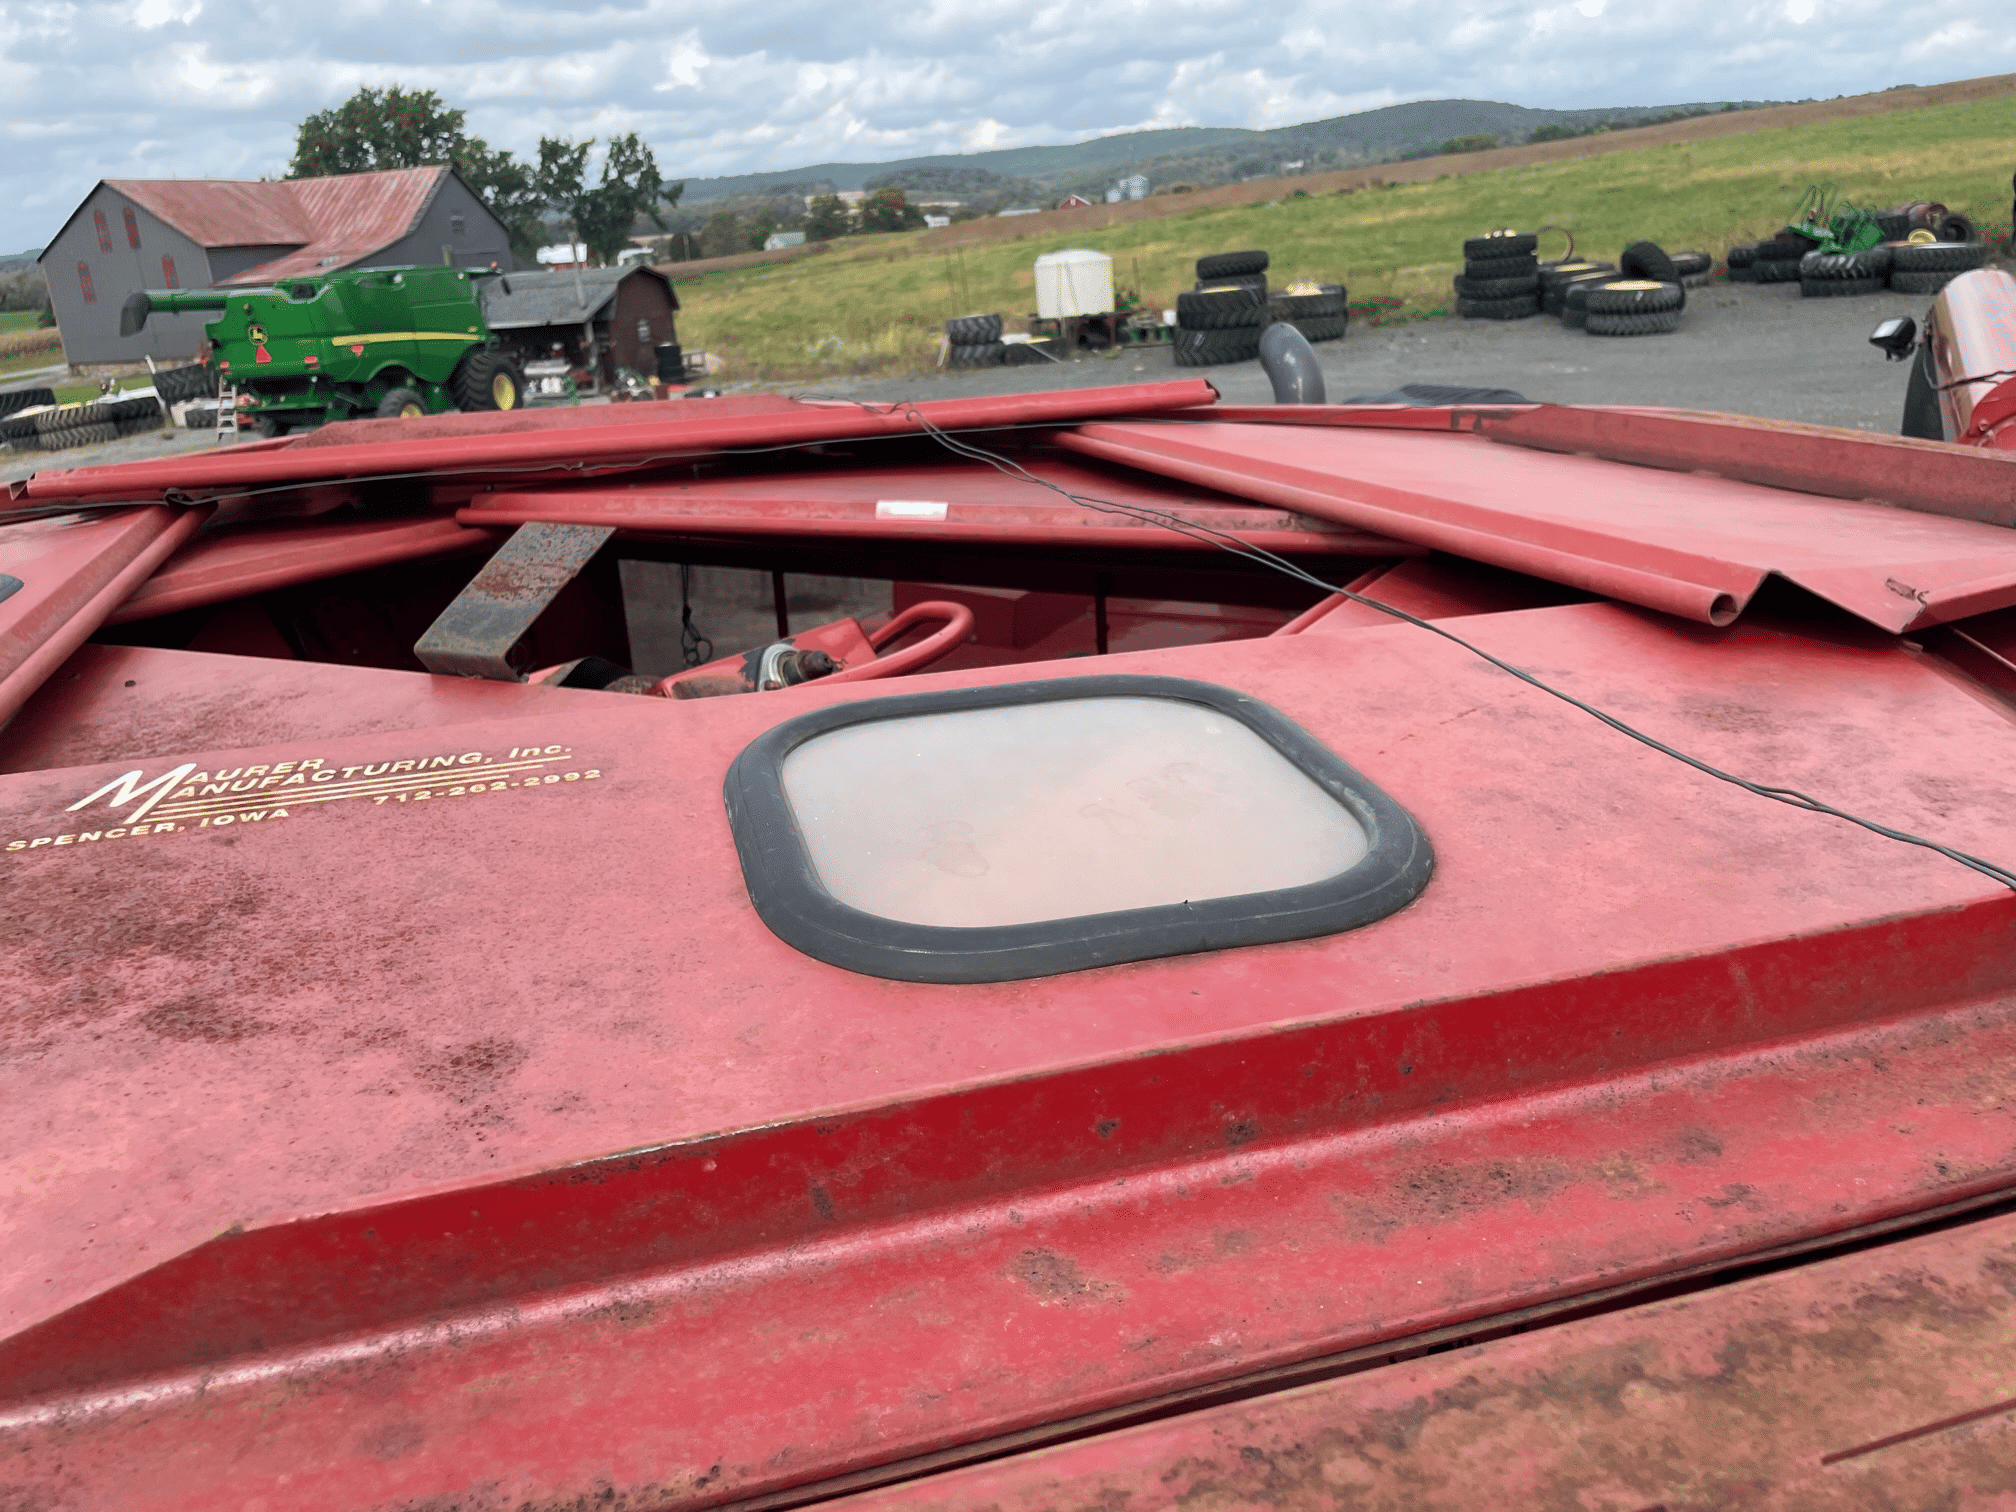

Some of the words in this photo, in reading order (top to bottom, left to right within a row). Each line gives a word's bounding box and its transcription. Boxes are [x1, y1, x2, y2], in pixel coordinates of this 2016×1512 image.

[508, 744, 572, 759] Inc.
[5, 822, 186, 851] SPENCER,
[200, 808, 290, 828] IOWA
